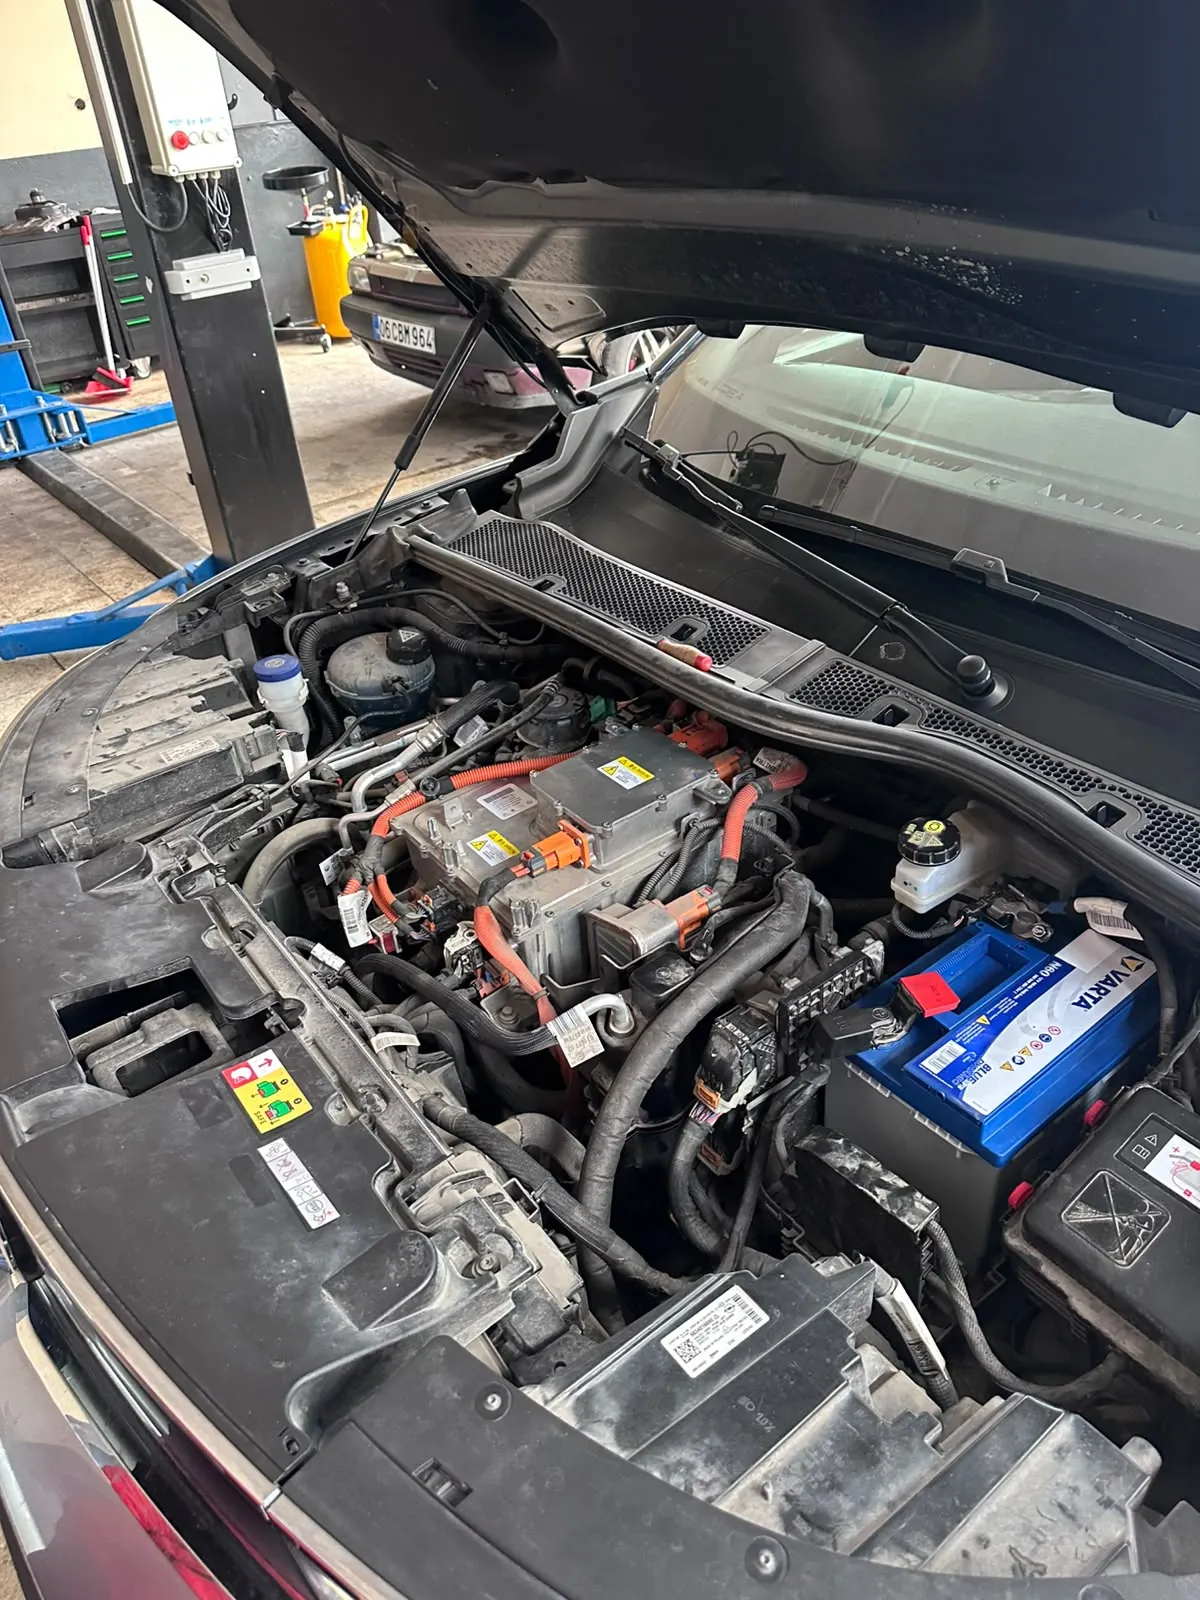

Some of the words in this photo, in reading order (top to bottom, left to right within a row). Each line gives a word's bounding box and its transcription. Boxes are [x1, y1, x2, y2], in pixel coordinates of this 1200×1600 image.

[1041, 960, 1063, 977] N60
[1071, 969, 1131, 1010] VARTA
[967, 1063, 992, 1085] BLUE
[254, 1111, 267, 1124] SAFE
